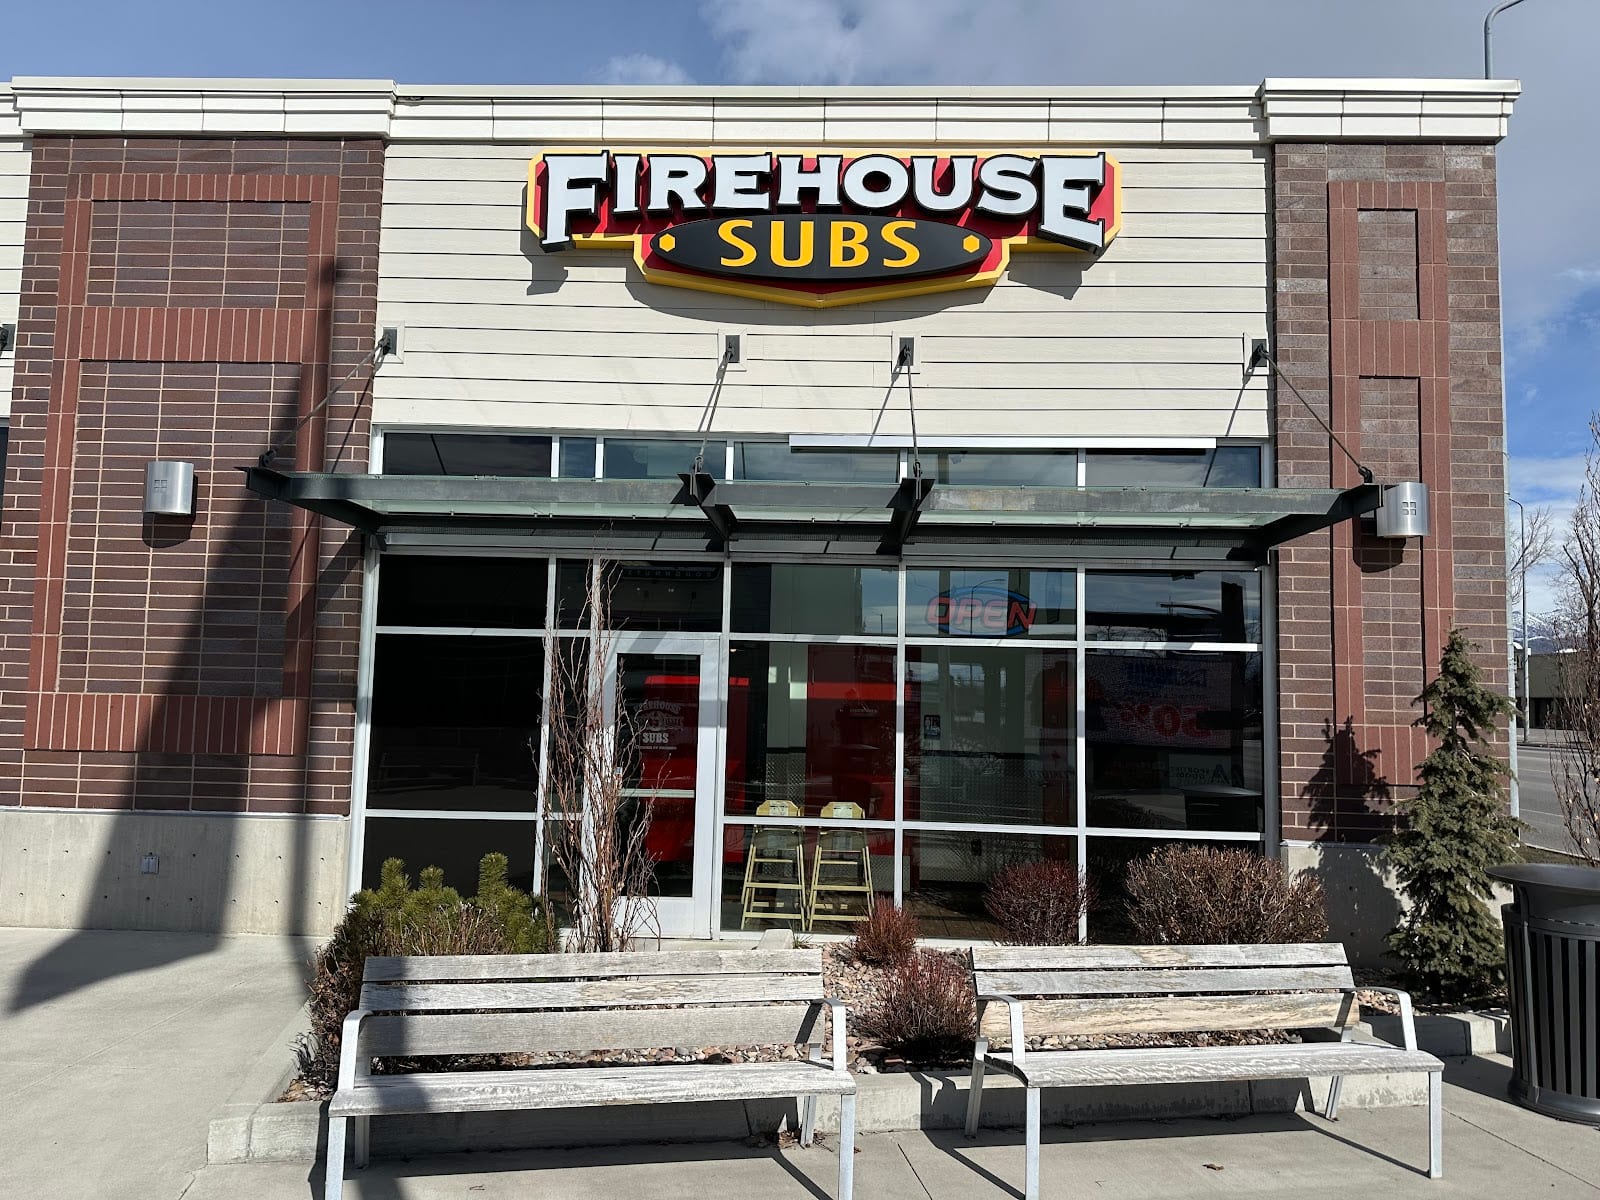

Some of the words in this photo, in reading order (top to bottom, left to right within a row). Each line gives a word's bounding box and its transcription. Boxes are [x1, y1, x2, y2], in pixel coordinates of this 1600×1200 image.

[541, 151, 1107, 252] FIREHOUSE
[717, 219, 921, 269] SUBS
[927, 596, 1038, 630] OPEN
[642, 732, 669, 744] SUBS
